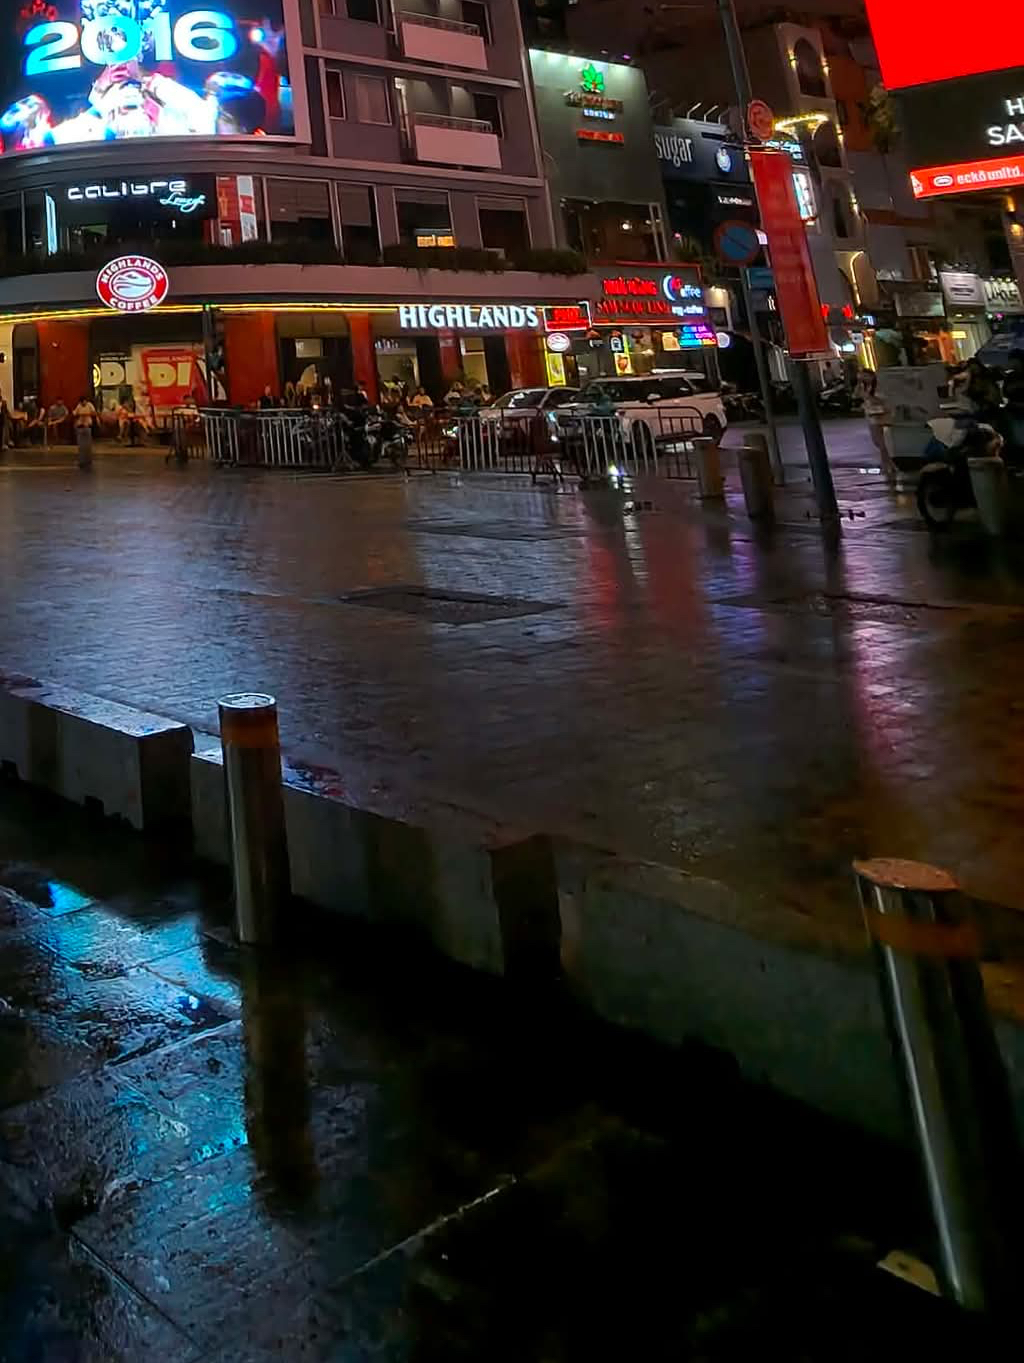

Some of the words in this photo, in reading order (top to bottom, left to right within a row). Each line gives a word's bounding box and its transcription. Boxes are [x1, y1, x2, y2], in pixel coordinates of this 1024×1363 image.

[22, 9, 239, 76] 2016
[100, 258, 164, 284] HIGHLANDS
[109, 295, 159, 311] COFFEE
[398, 305, 539, 328] HIGHLANDS
